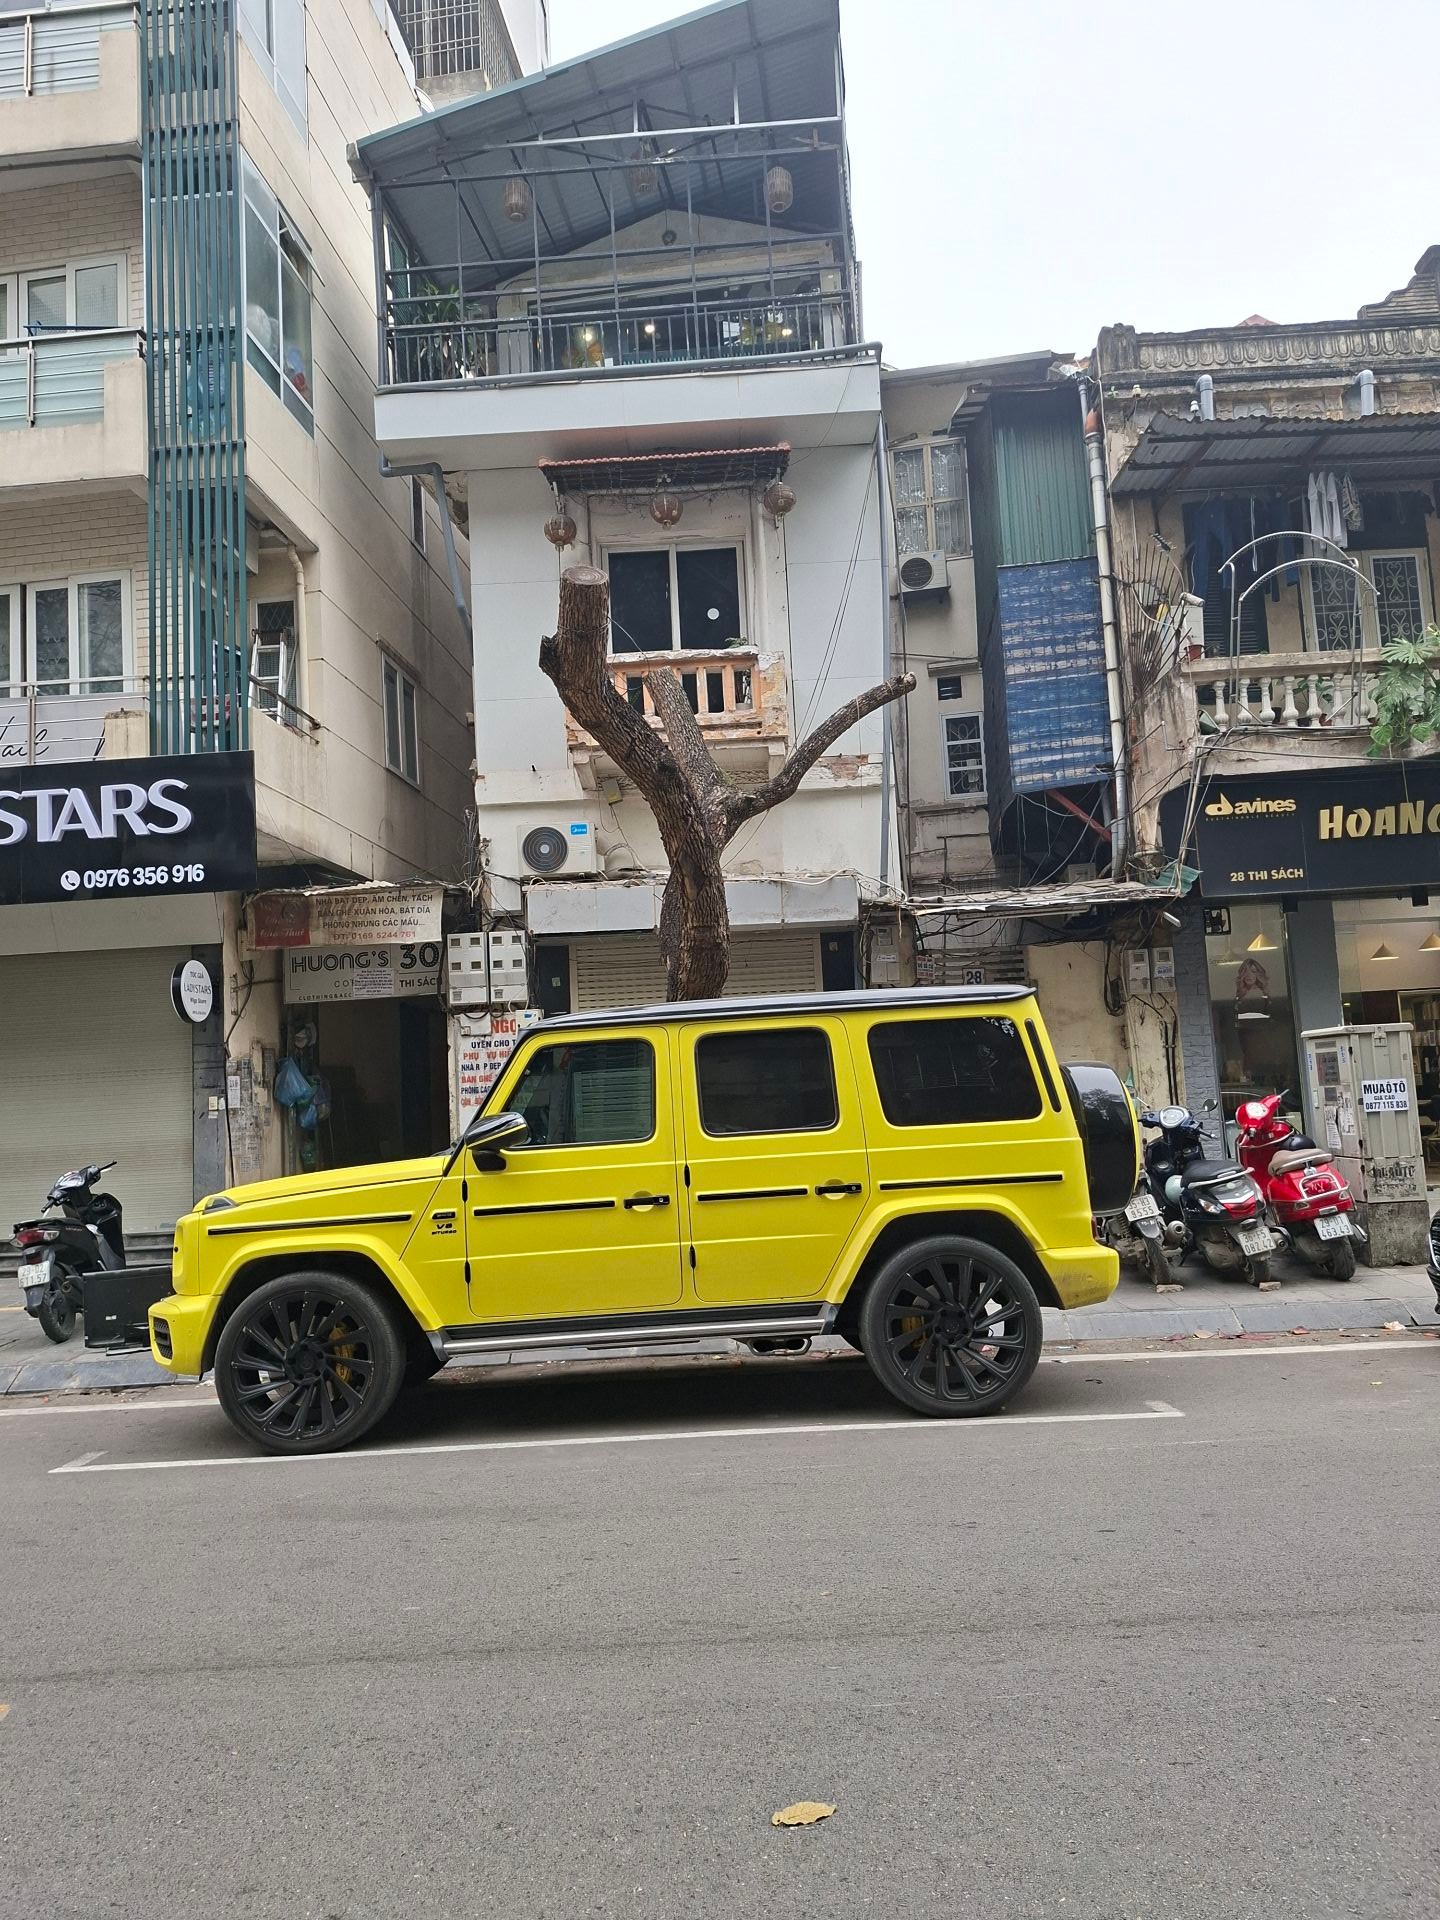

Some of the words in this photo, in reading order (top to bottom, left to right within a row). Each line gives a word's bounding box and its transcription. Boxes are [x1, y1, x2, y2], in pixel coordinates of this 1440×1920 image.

[1205, 792, 1297, 816] davines
[83, 867, 130, 889] 0976
[132, 864, 169, 886] 356
[171, 863, 205, 884] 916
[1230, 872, 1245, 882] 28
[1247, 871, 1268, 881] THI
[1271, 866, 1304, 880] SÁCH
[400, 942, 440, 970] 30
[399, 980, 415, 988] THI
[966, 970, 982, 985] 28
[1383, 1100, 1395, 1109] 115
